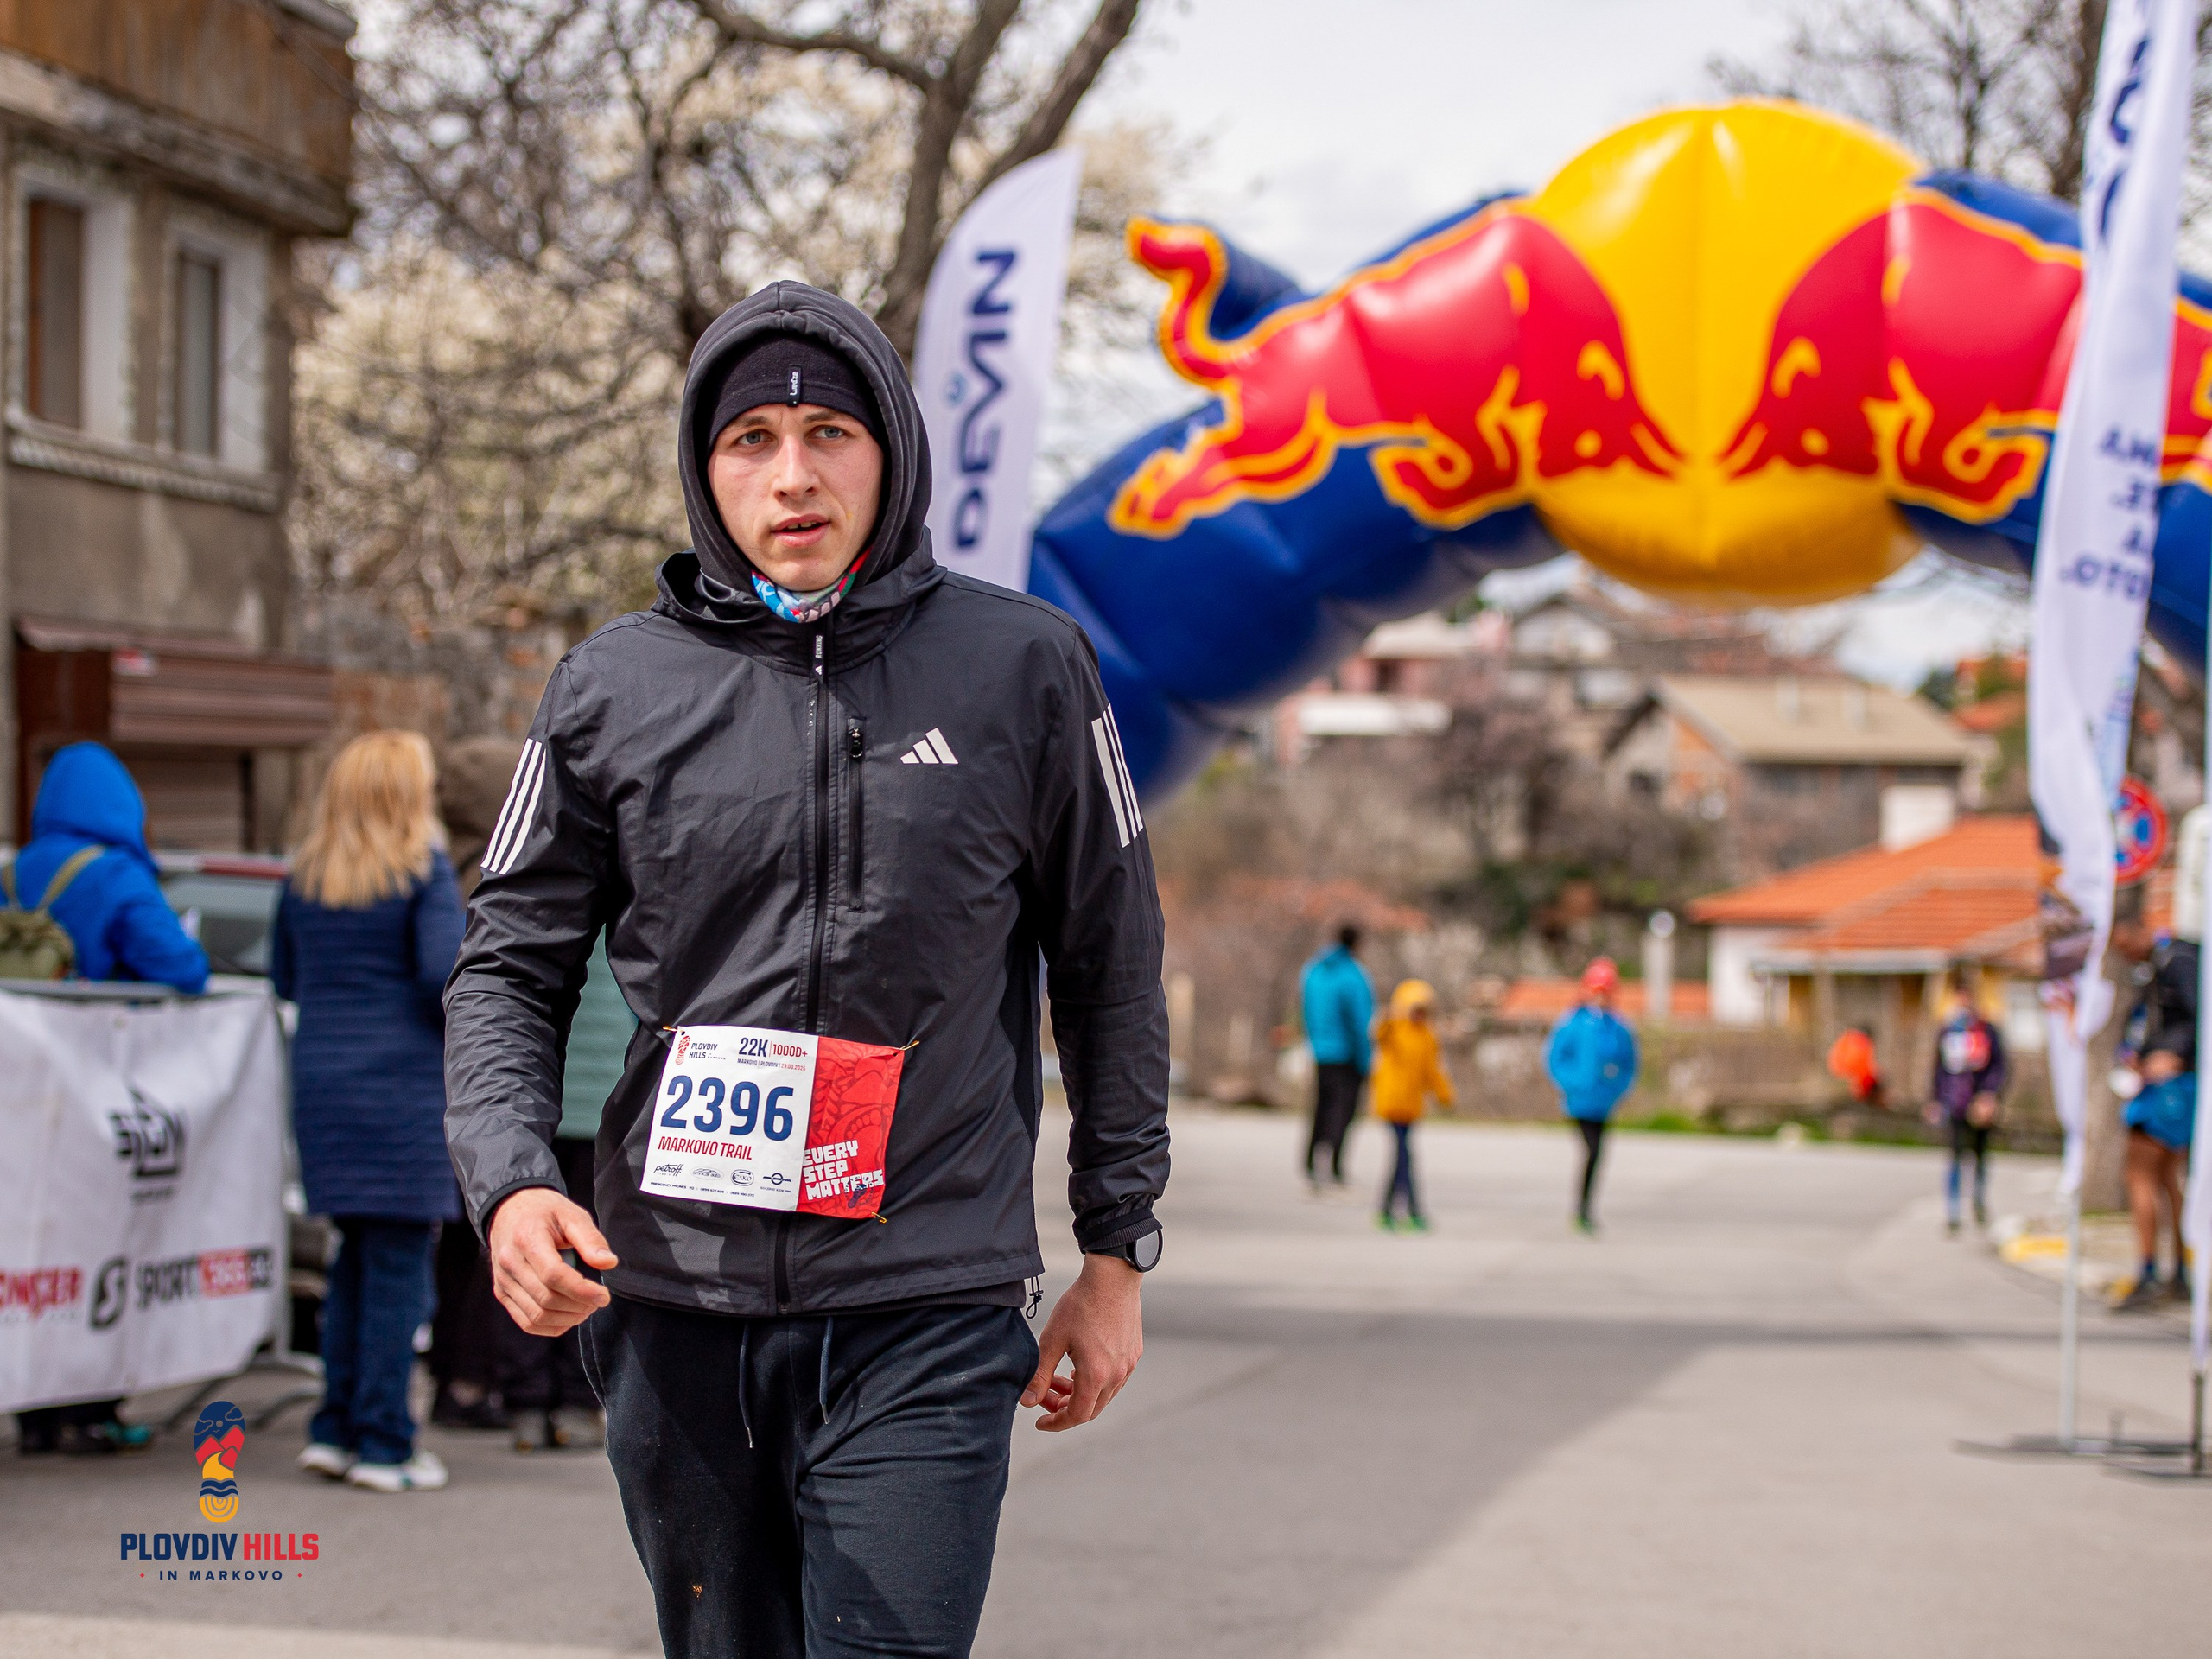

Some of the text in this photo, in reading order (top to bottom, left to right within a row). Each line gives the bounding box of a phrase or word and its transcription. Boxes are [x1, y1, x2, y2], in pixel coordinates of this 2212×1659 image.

[956, 250, 1018, 548] DEVIN
[691, 1042, 718, 1051] PLOVDIV
[739, 1037, 768, 1058] 22K
[773, 1044, 808, 1058] 1000D+
[660, 1075, 794, 1141] 2396
[658, 1136, 753, 1160] MARKOVO TRAIL
[803, 1140, 858, 1166] EVERY
[803, 1160, 848, 1184] STEP
[806, 1169, 884, 1200] MATTERS
